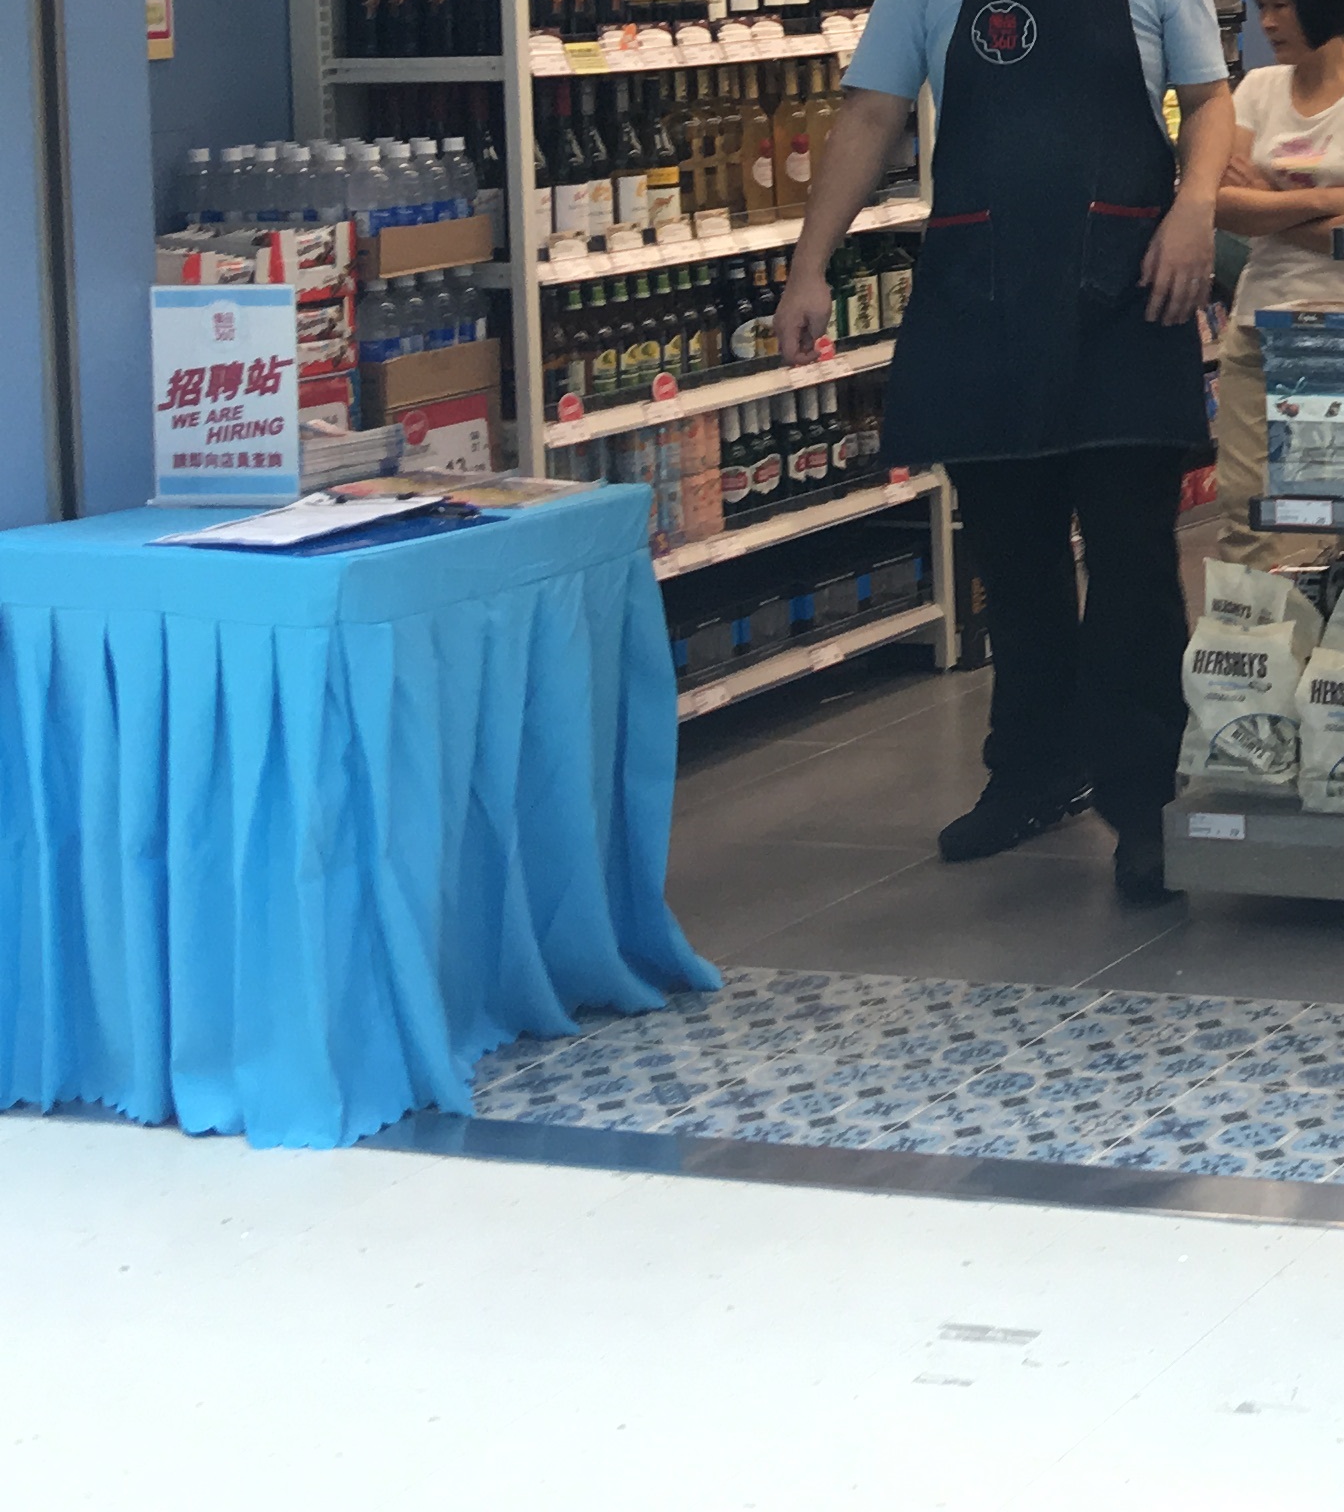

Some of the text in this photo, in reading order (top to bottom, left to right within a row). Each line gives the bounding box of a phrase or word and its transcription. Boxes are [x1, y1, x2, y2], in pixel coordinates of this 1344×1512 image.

[157, 354, 294, 412] 招聘站
[171, 404, 245, 430] WE ARE
[205, 415, 285, 446] HIRING
